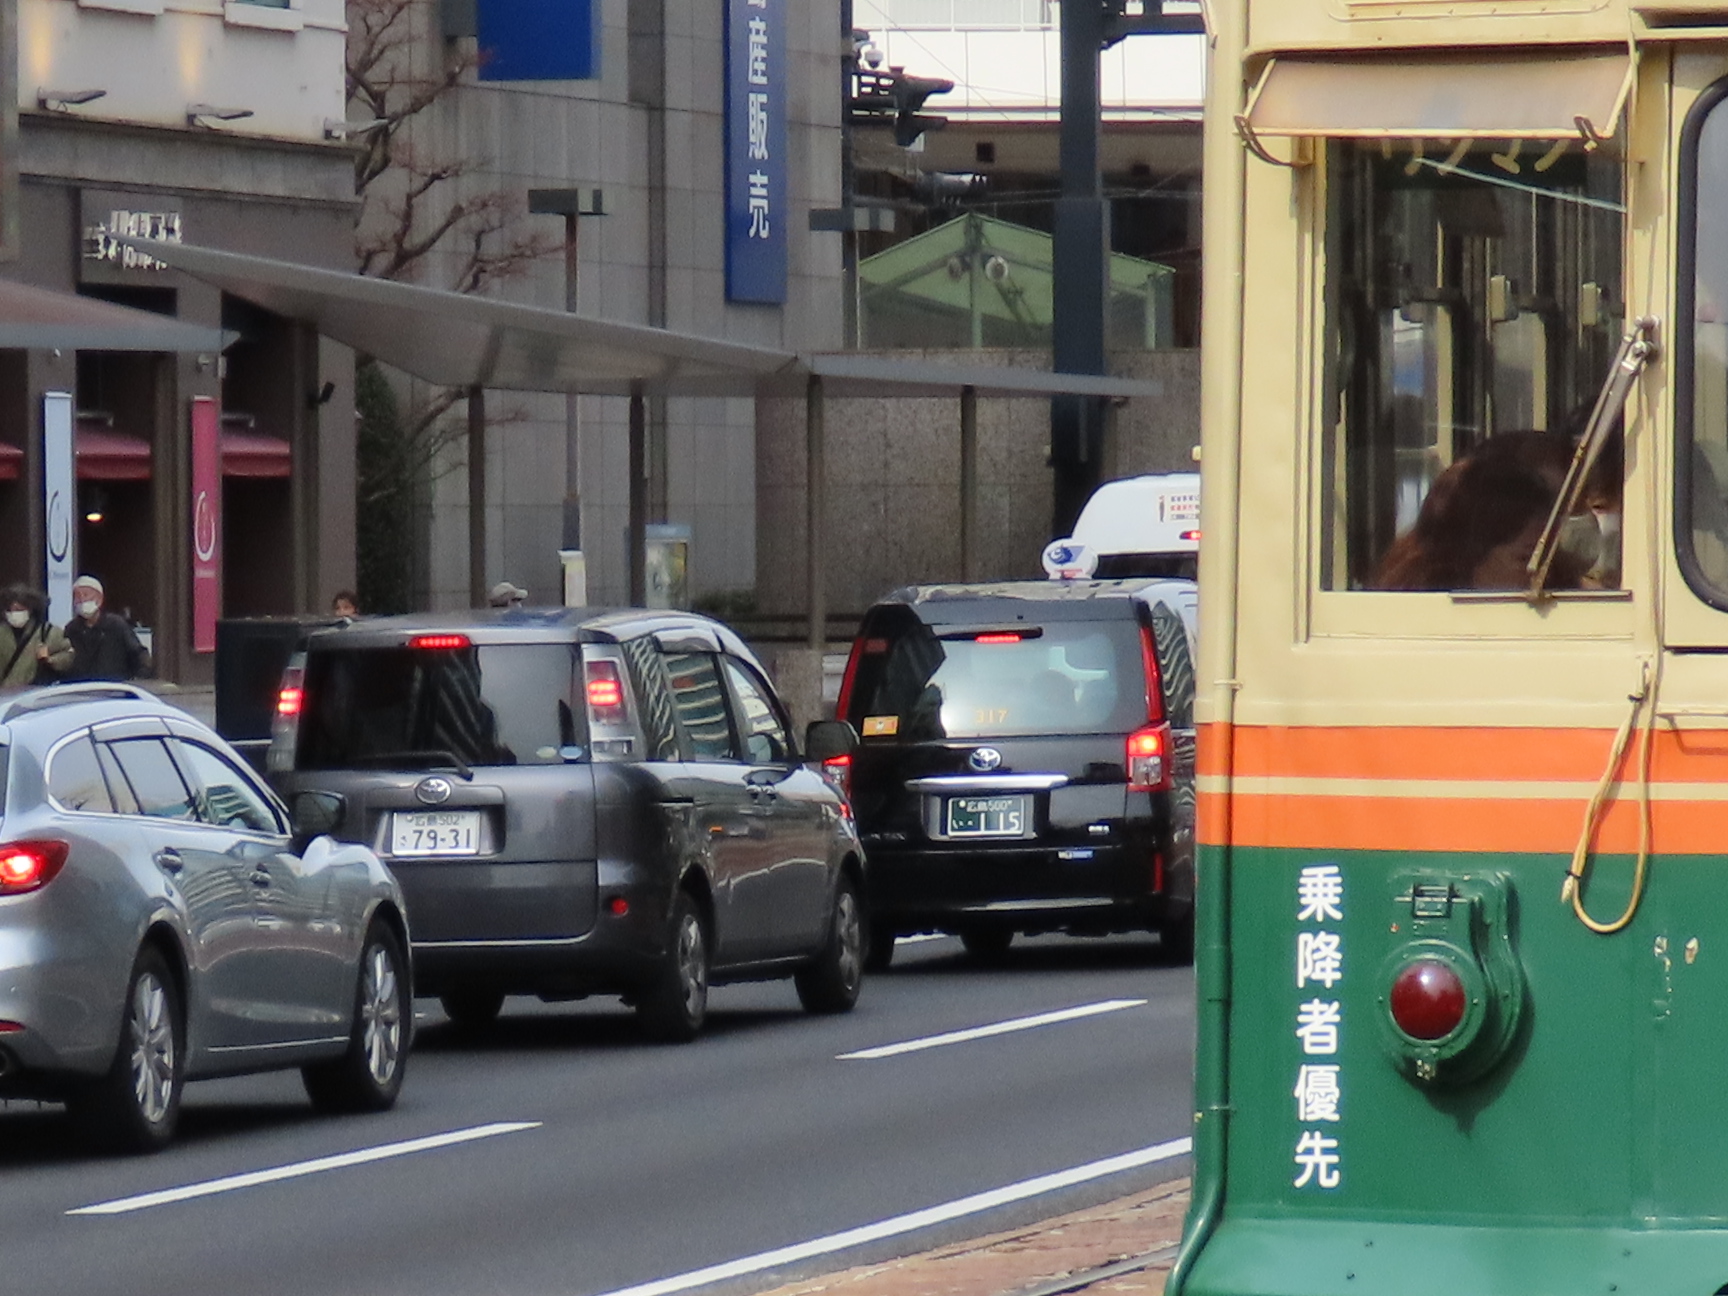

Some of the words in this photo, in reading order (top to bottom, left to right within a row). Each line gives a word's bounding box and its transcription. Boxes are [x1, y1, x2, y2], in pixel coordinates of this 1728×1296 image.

[411, 828, 472, 850] 79-31
[1292, 864, 1344, 1190] 乗降者優先
